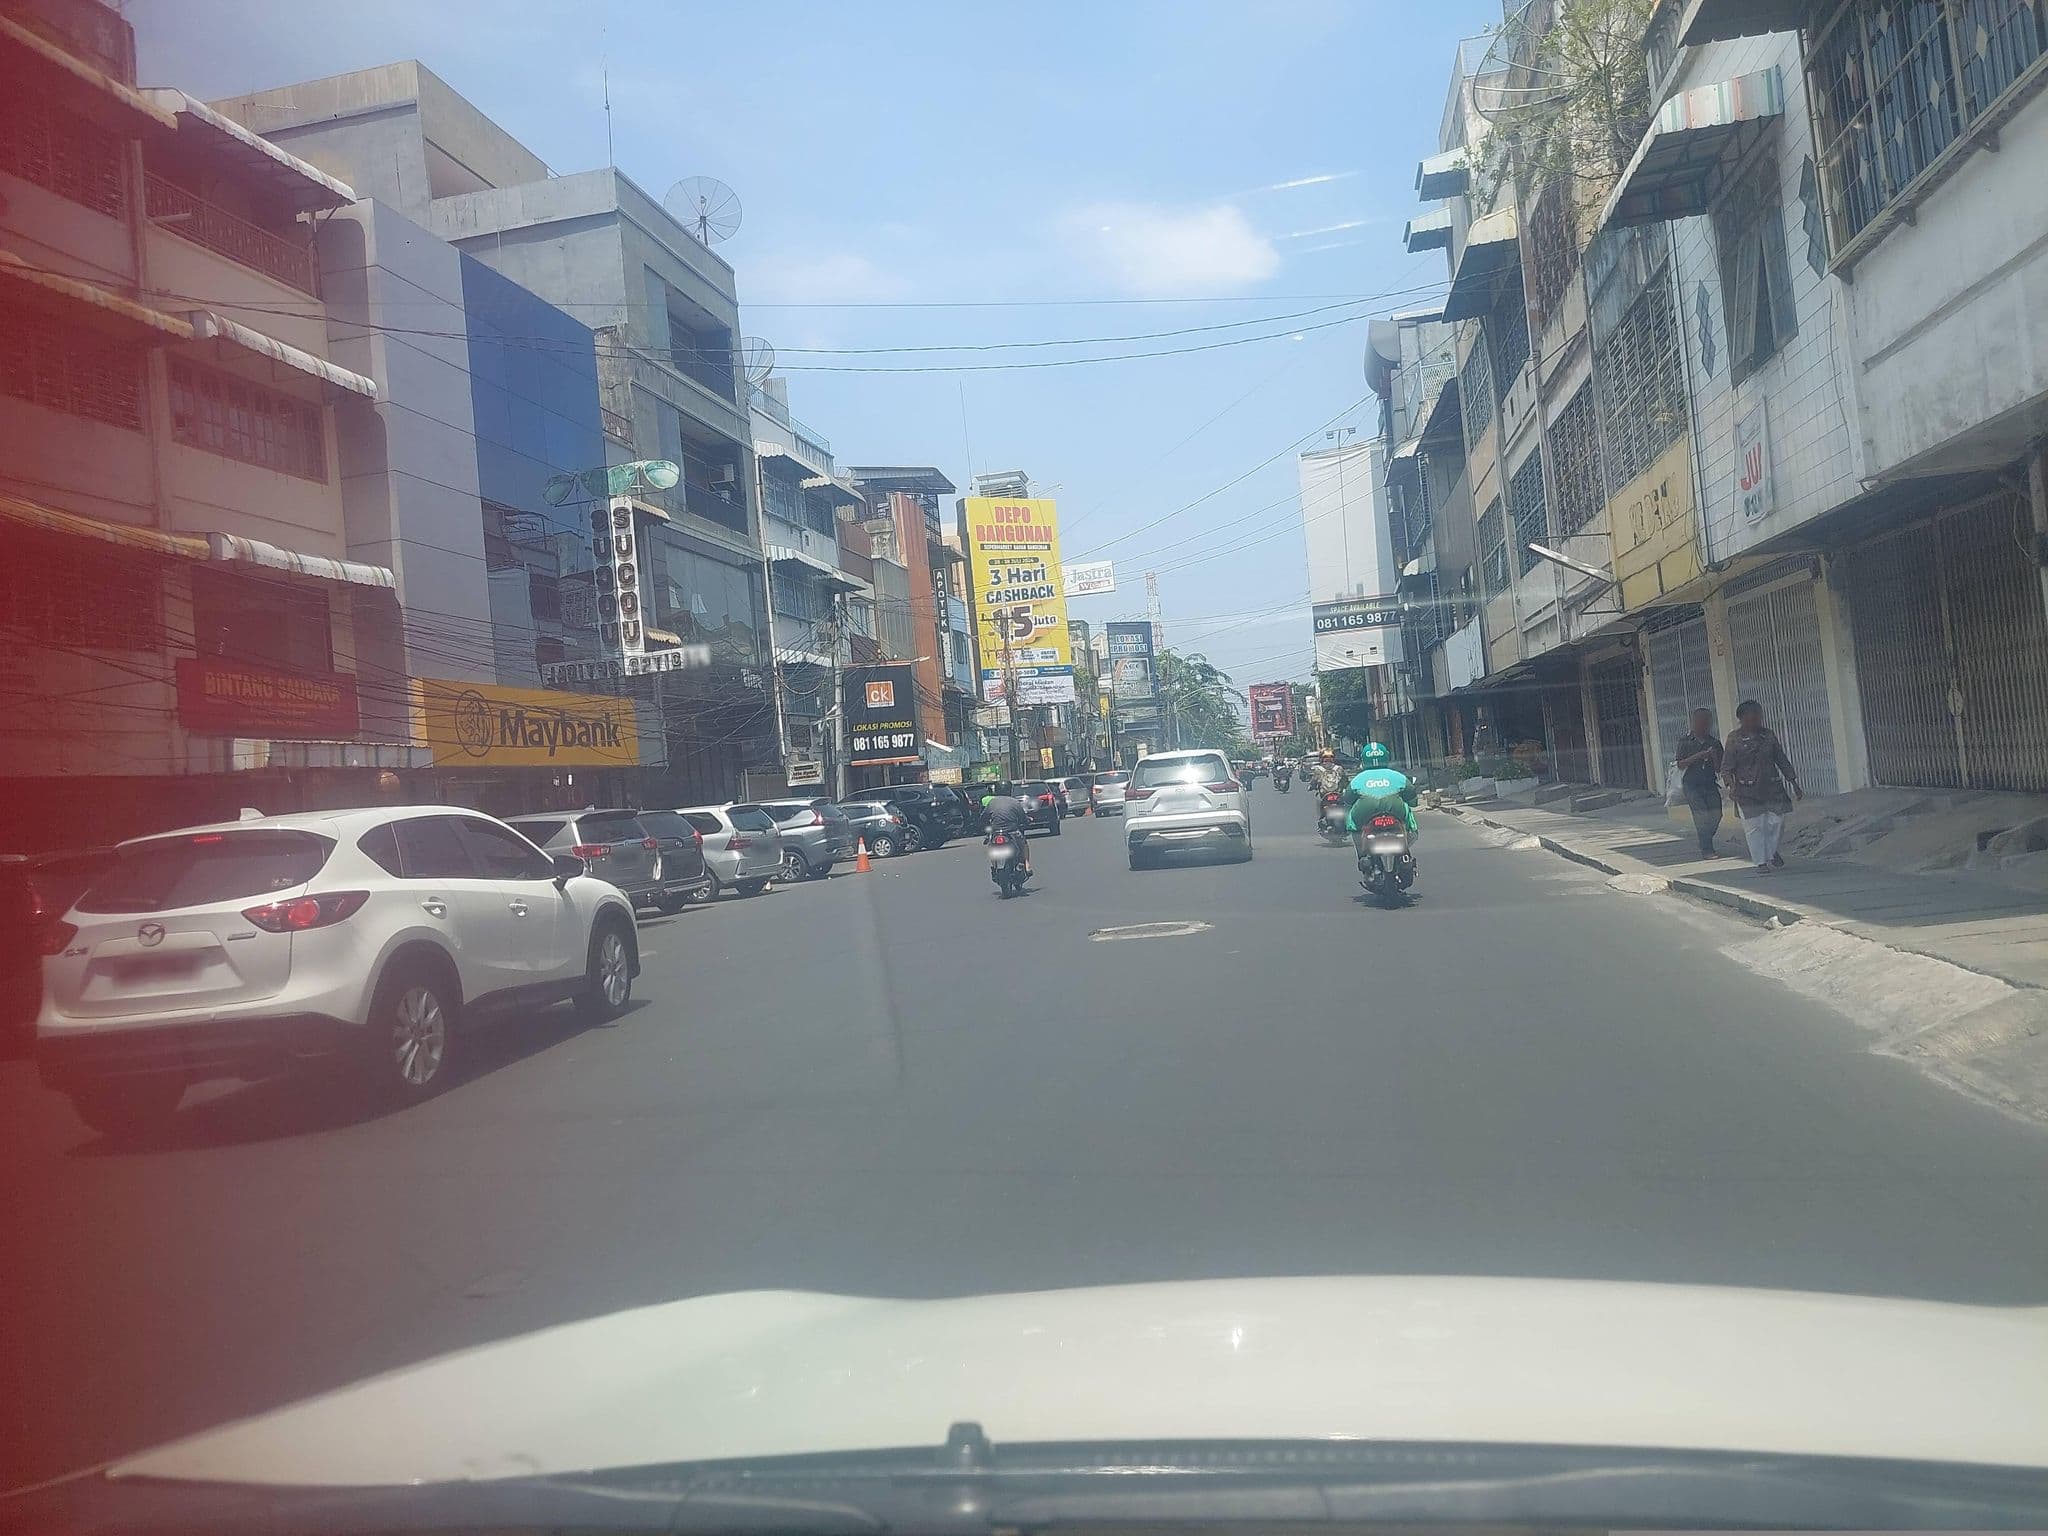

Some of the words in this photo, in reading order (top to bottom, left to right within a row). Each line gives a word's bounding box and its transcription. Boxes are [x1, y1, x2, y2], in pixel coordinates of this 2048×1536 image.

[994, 506, 1031, 524] DEPO
[975, 524, 1053, 543] BANGUNAN
[990, 569, 1001, 585] 3
[1007, 563, 1046, 584] Hari
[936, 570, 948, 628] APOTEK
[986, 584, 1055, 604] CASHBACK
[1034, 615, 1057, 626] Juta
[1316, 617, 1339, 630] 081
[1341, 615, 1363, 627] 165
[1366, 610, 1396, 624] 9877
[1112, 643, 1147, 653] PROMOSI
[1115, 634, 1143, 644] LOKASI
[202, 672, 273, 698] BINTANG
[278, 678, 342, 702] SAUDARA
[870, 687, 889, 702] ck
[499, 709, 622, 757] Maybank
[852, 722, 879, 732] LOKASI
[879, 720, 913, 731] PROMOSI
[853, 737, 871, 752] 081
[871, 735, 890, 750] 165
[891, 733, 915, 748] 9877
[1365, 749, 1385, 758] Grab
[1365, 779, 1391, 788] Grab
